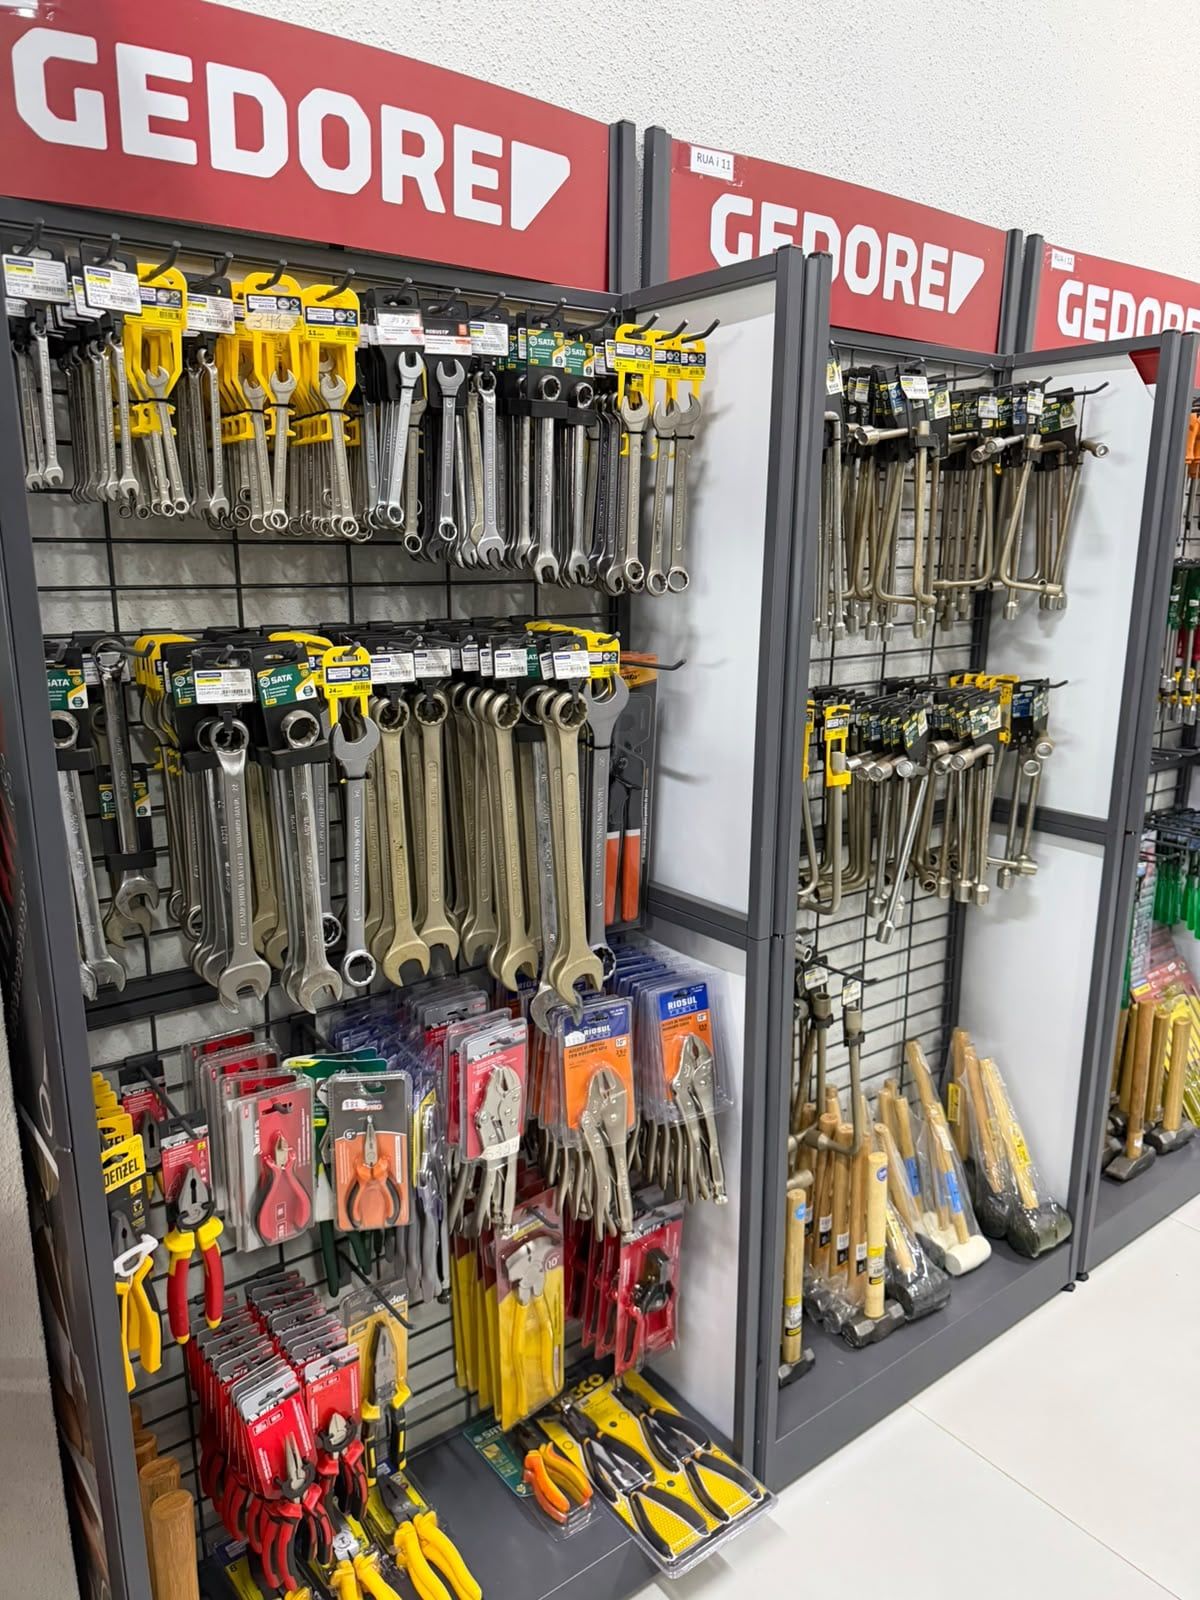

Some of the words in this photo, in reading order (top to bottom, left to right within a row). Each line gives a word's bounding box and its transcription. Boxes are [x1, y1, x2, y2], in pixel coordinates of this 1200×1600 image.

[12, 27, 503, 226] GEDORE
[696, 152, 715, 167] RUA
[721, 159, 731, 170] 11
[710, 192, 949, 312] GEDORE
[537, 337, 556, 347] SATA
[571, 348, 587, 357] SATA
[270, 673, 293, 684] SATA
[667, 995, 698, 1010] RIOSUL
[583, 1024, 612, 1036] RIOSUL
